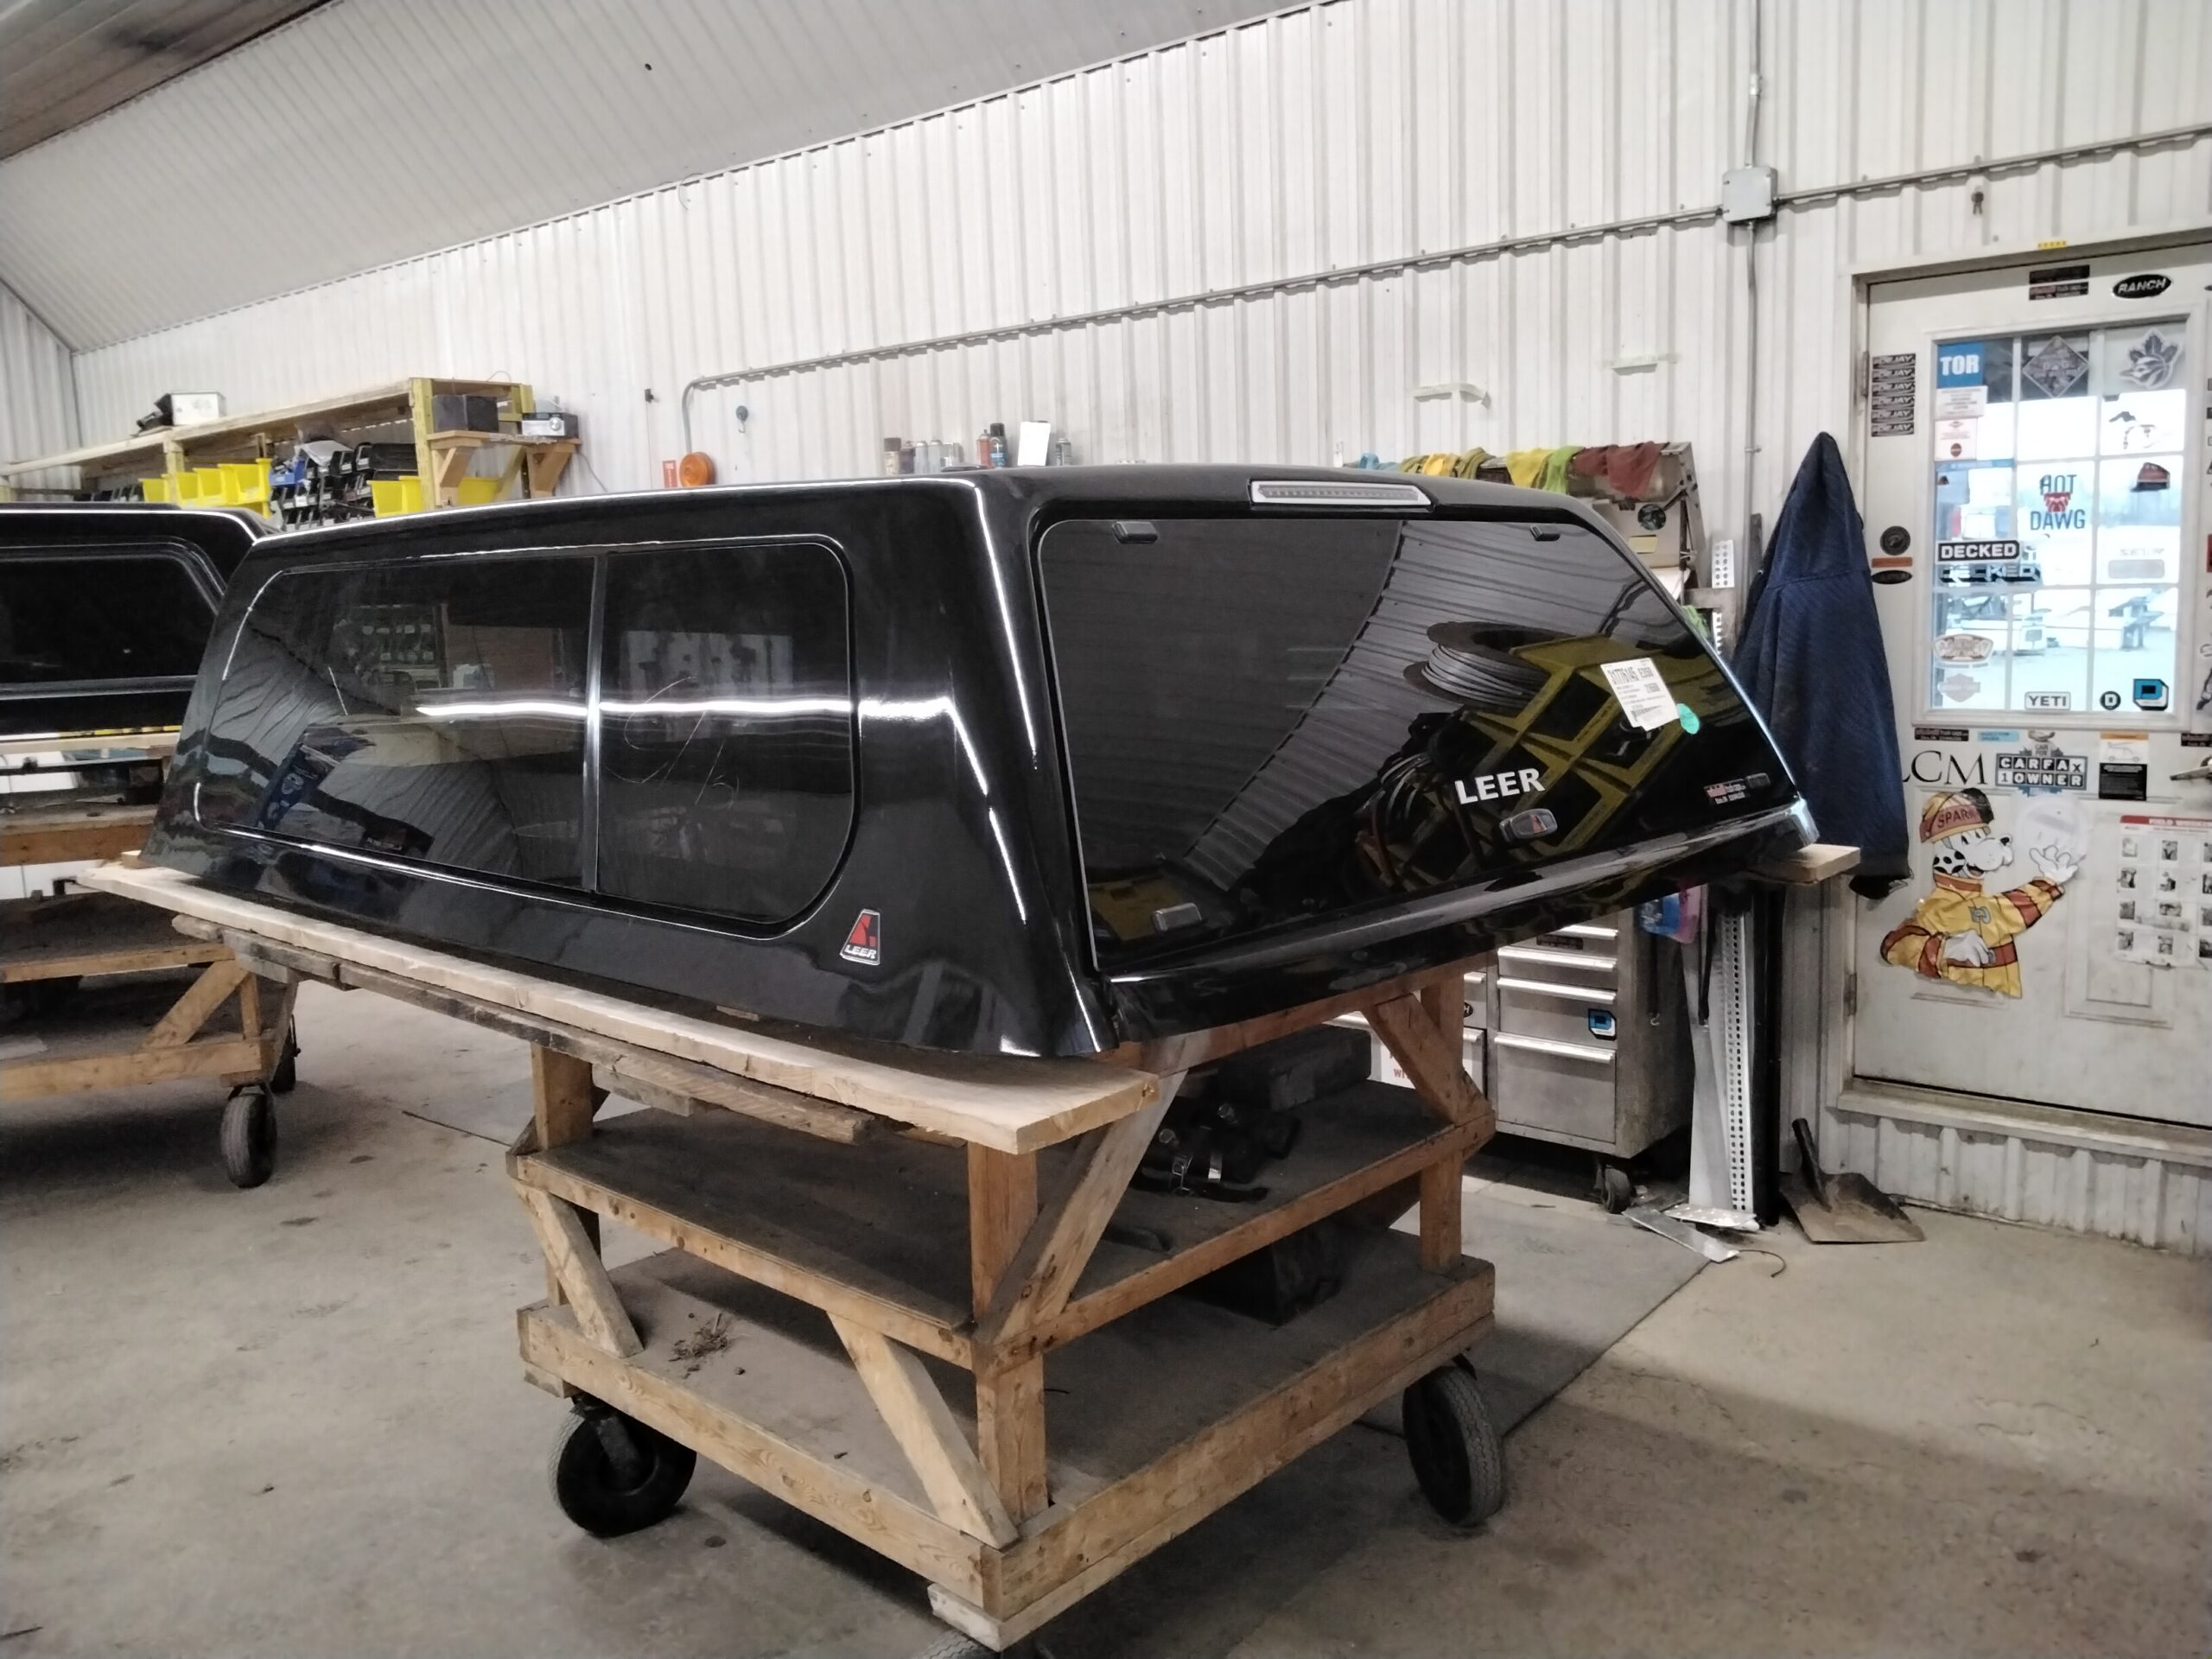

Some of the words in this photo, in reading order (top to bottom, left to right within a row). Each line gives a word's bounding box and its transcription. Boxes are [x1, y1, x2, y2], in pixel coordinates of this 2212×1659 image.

[2118, 277, 2167, 294] RANCH
[1940, 354, 1980, 376] TOR
[2031, 508, 2086, 531] DAWG
[1941, 542, 2017, 559] DECKED
[2029, 696, 2067, 707] YETI
[1999, 757, 2082, 773] CARFAX
[1454, 767, 1546, 804] LEER
[2014, 773, 2082, 787] OWNER
[844, 944, 877, 959] LEER
